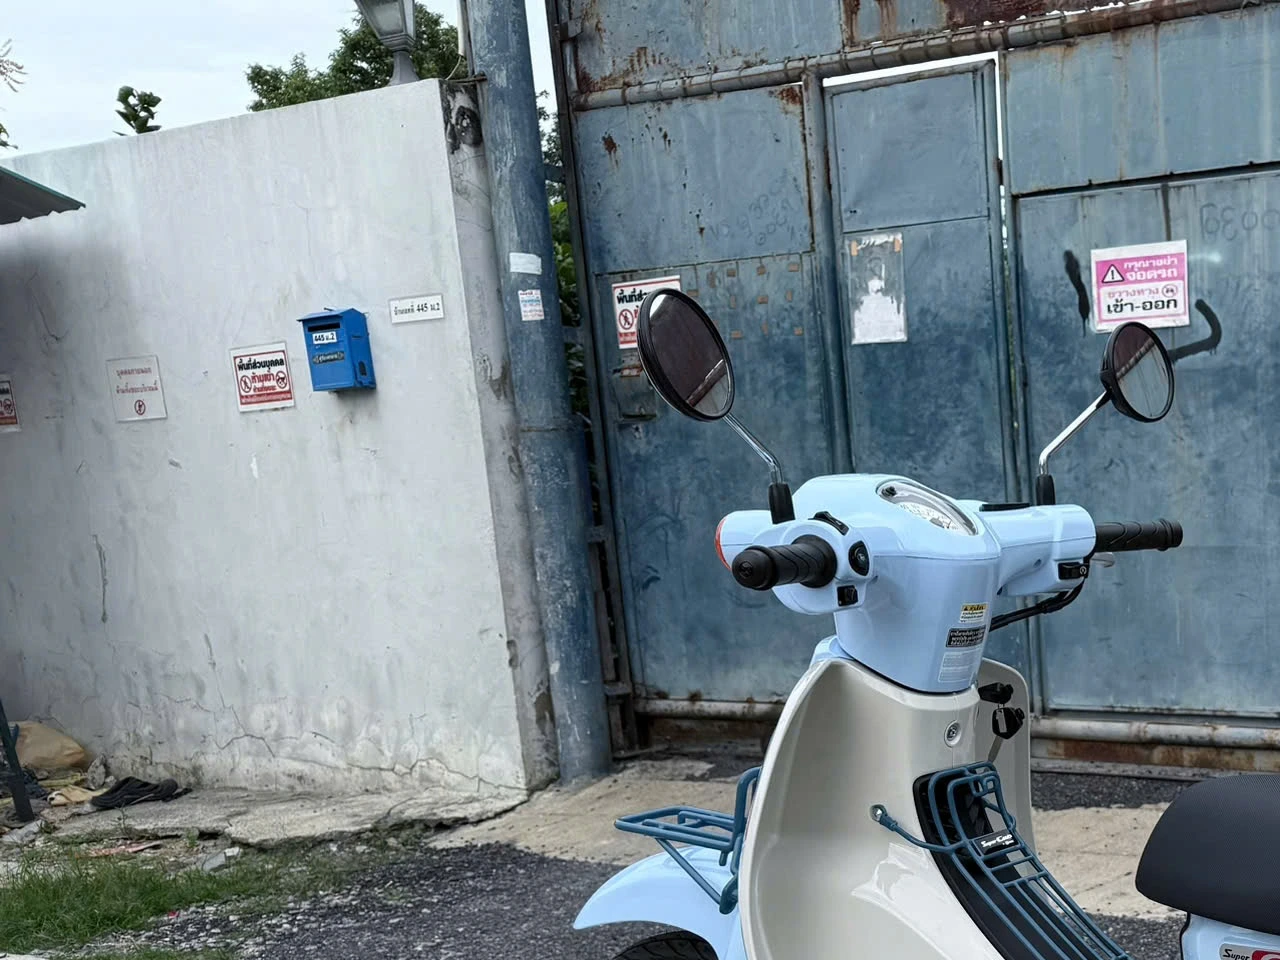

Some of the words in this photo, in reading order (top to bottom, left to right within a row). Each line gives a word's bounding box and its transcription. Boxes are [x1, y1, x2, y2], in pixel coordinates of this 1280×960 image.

[1126, 267, 1178, 282] จอดรถ
[416, 302, 429, 313] 445
[1107, 298, 1178, 315] เข้า-ออก
[1223, 948, 1250, 960] Super
